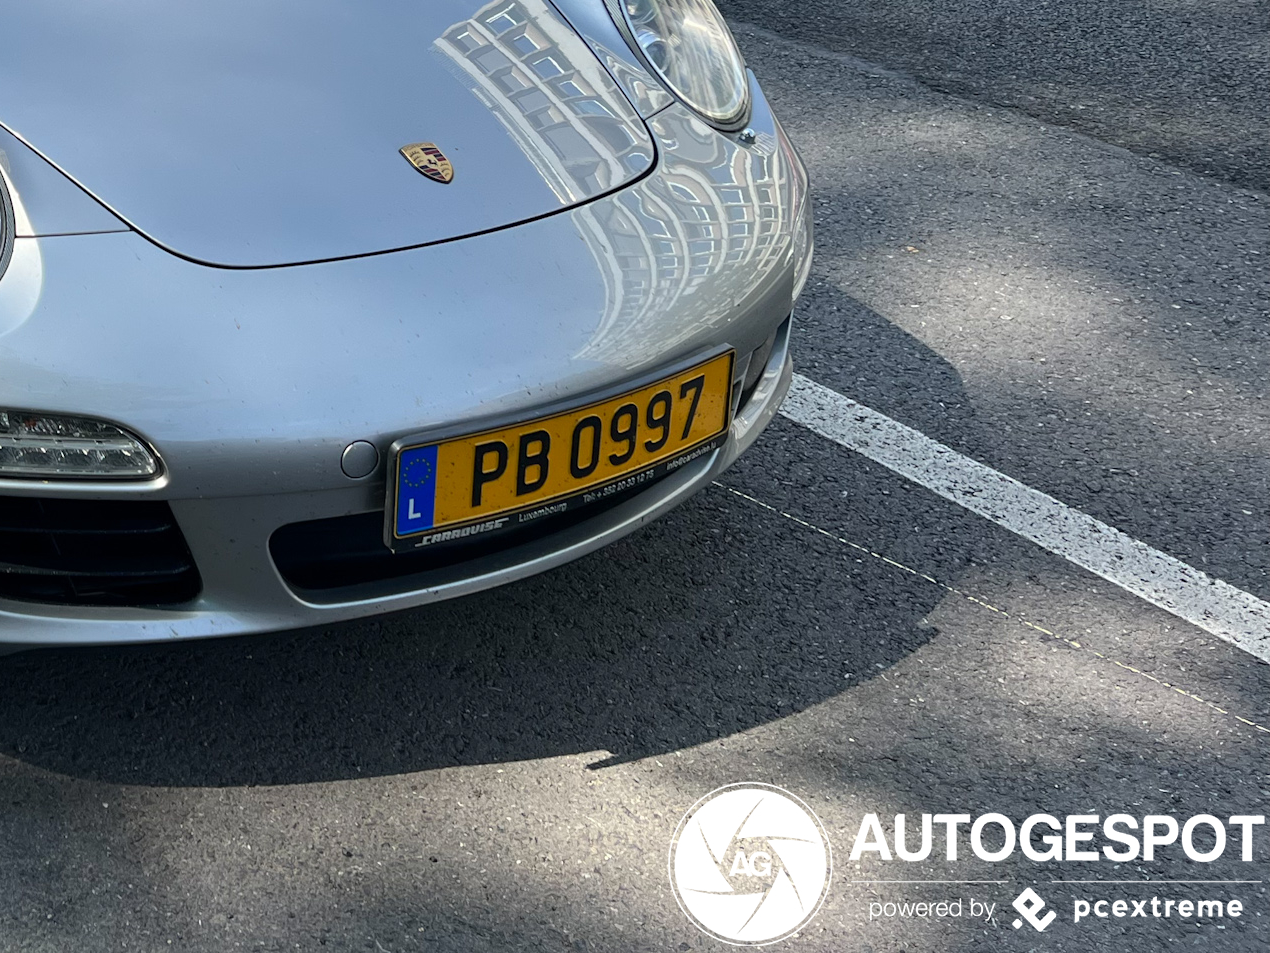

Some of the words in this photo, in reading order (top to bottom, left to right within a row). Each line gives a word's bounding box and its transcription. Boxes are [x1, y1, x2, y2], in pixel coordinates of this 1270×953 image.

[471, 429, 552, 508] PB
[569, 375, 705, 480] 0997
[407, 498, 421, 519] L
[518, 501, 568, 523] Luxembourg
